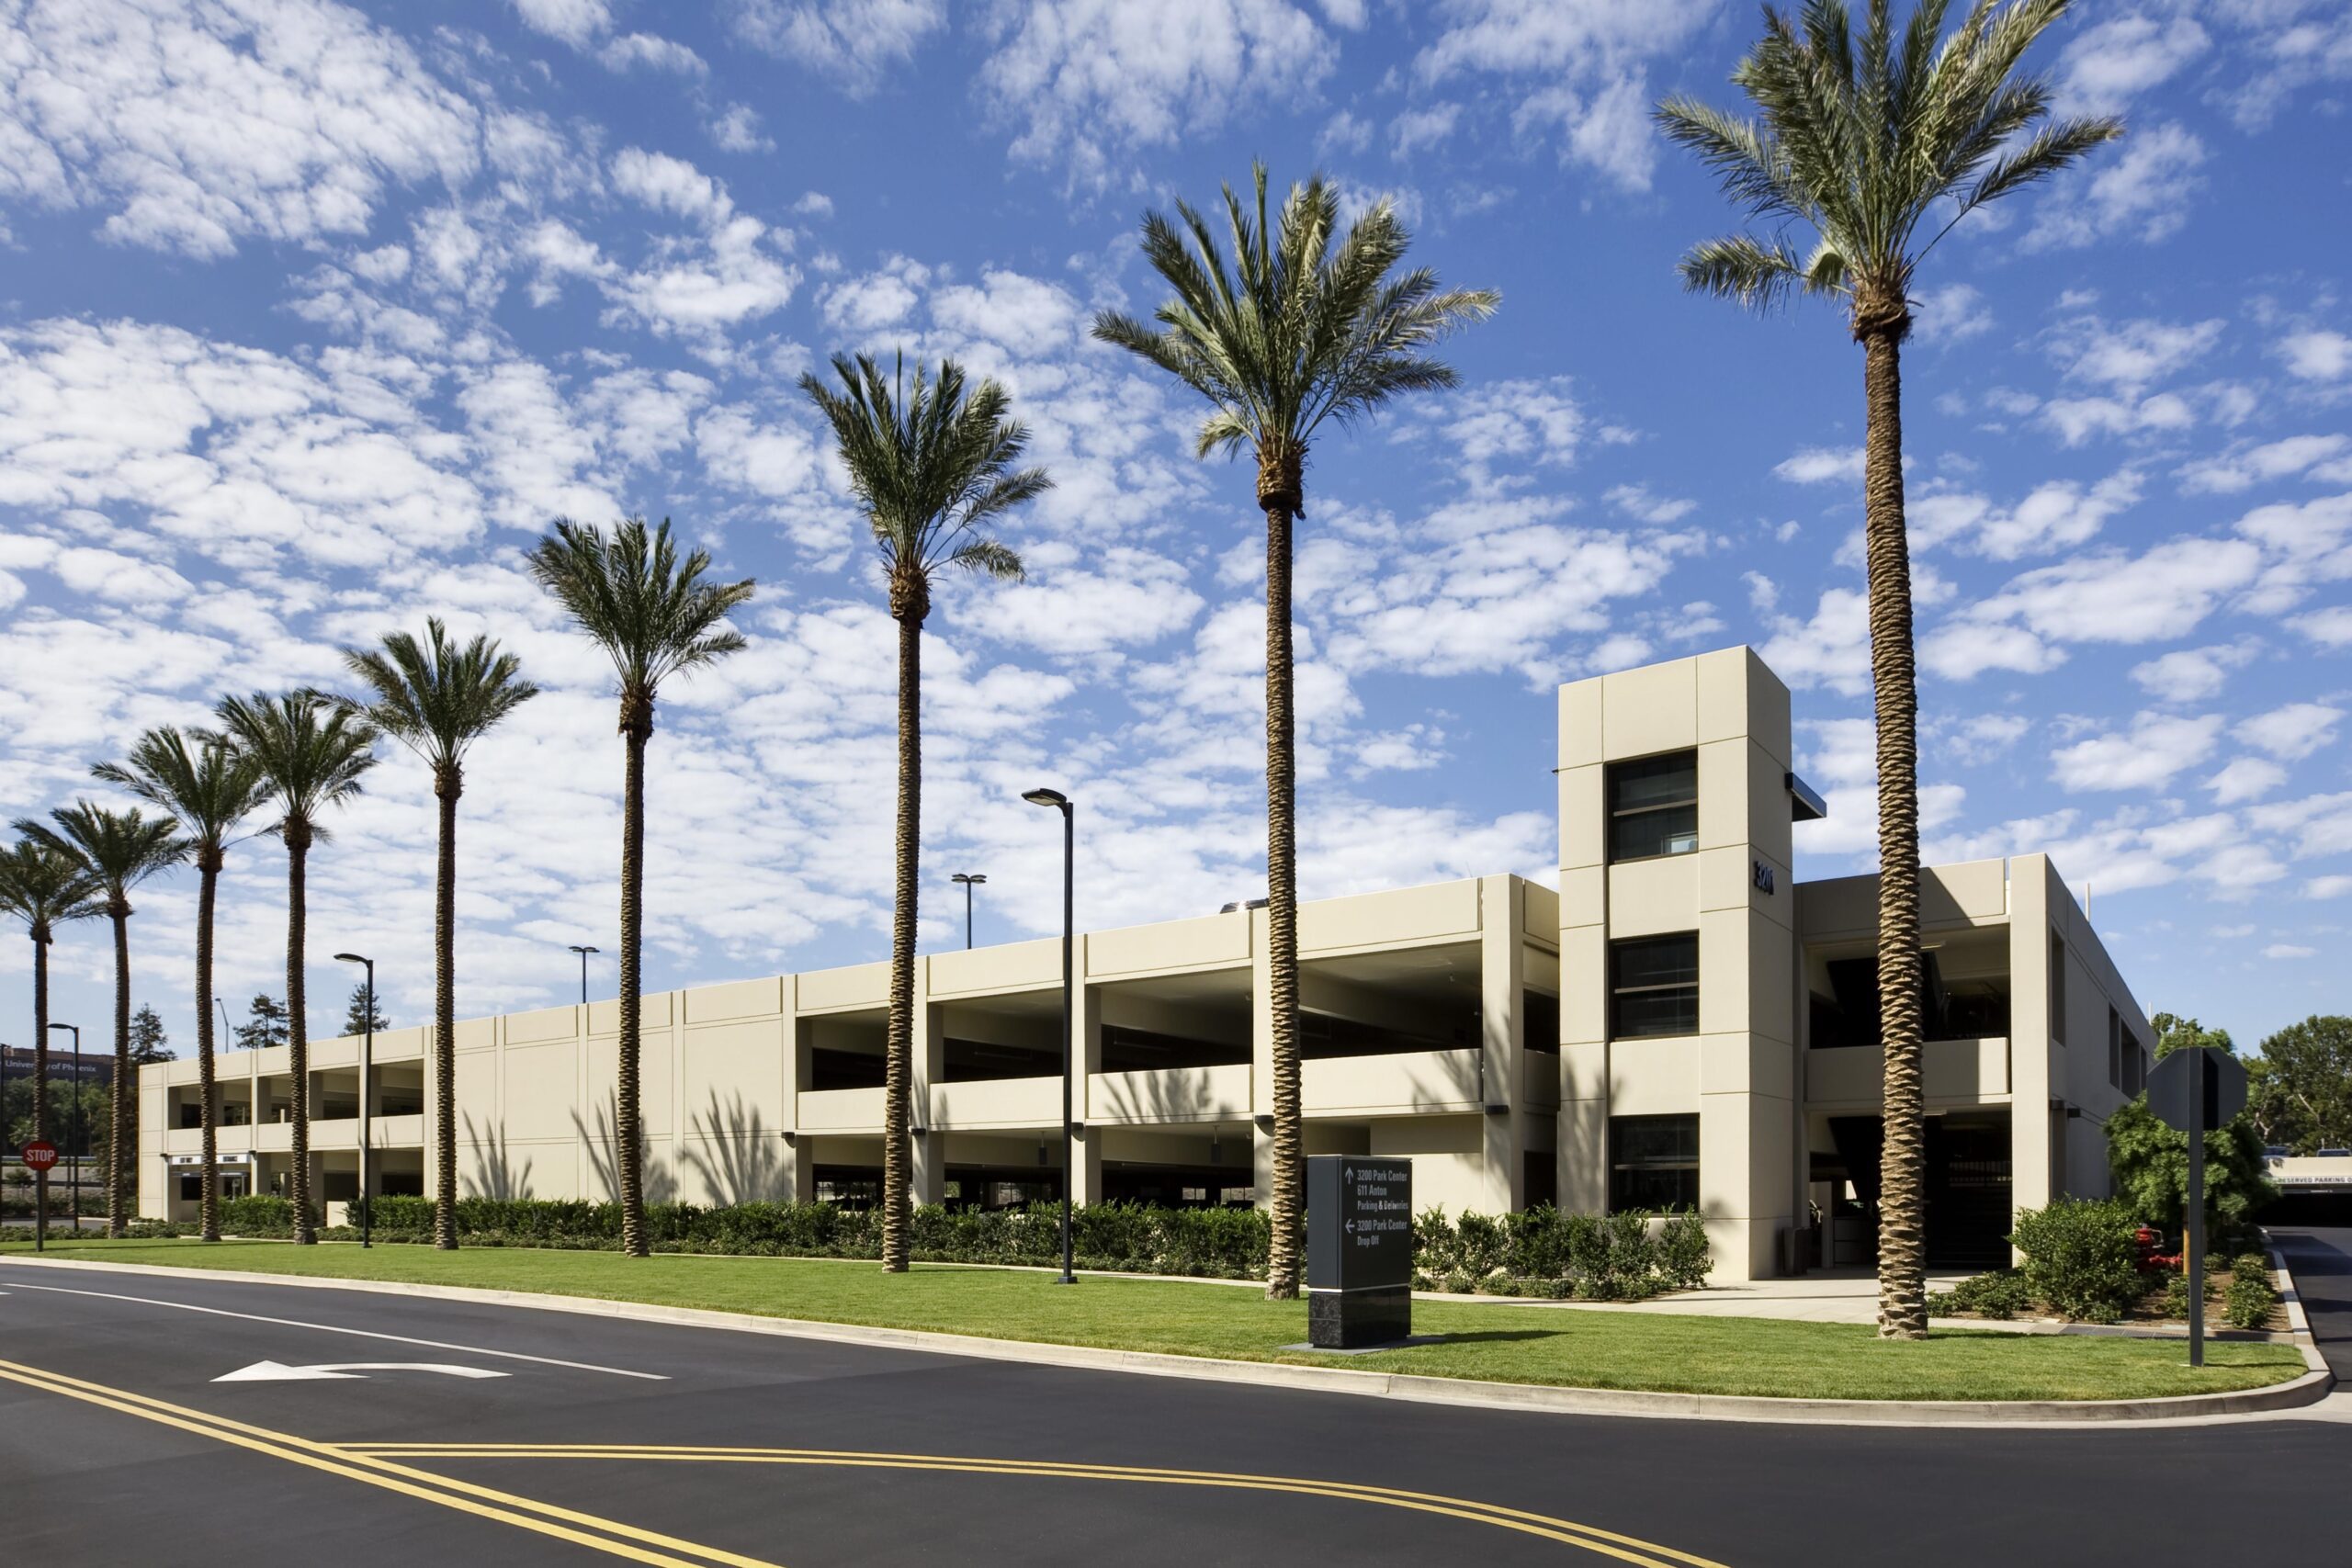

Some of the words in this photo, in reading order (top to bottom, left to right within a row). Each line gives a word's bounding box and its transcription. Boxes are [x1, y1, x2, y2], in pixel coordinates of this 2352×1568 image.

[62, 1063, 96, 1072] Phenix
[27, 1149, 55, 1162] STOP
[1357, 1169, 1373, 1181] 3200
[1373, 1169, 1387, 1181] Park
[1387, 1169, 1408, 1182] Center
[1357, 1184, 1367, 1196] 611
[1369, 1184, 1387, 1196] Anton
[1357, 1200, 1378, 1213] Parking
[1378, 1200, 1384, 1211] &
[1384, 1200, 1408, 1211] Deliveries
[1373, 1219, 1387, 1231] Park
[1387, 1219, 1408, 1231] Center
[1357, 1235, 1370, 1248] Drop
[1371, 1235, 1380, 1246] Off
